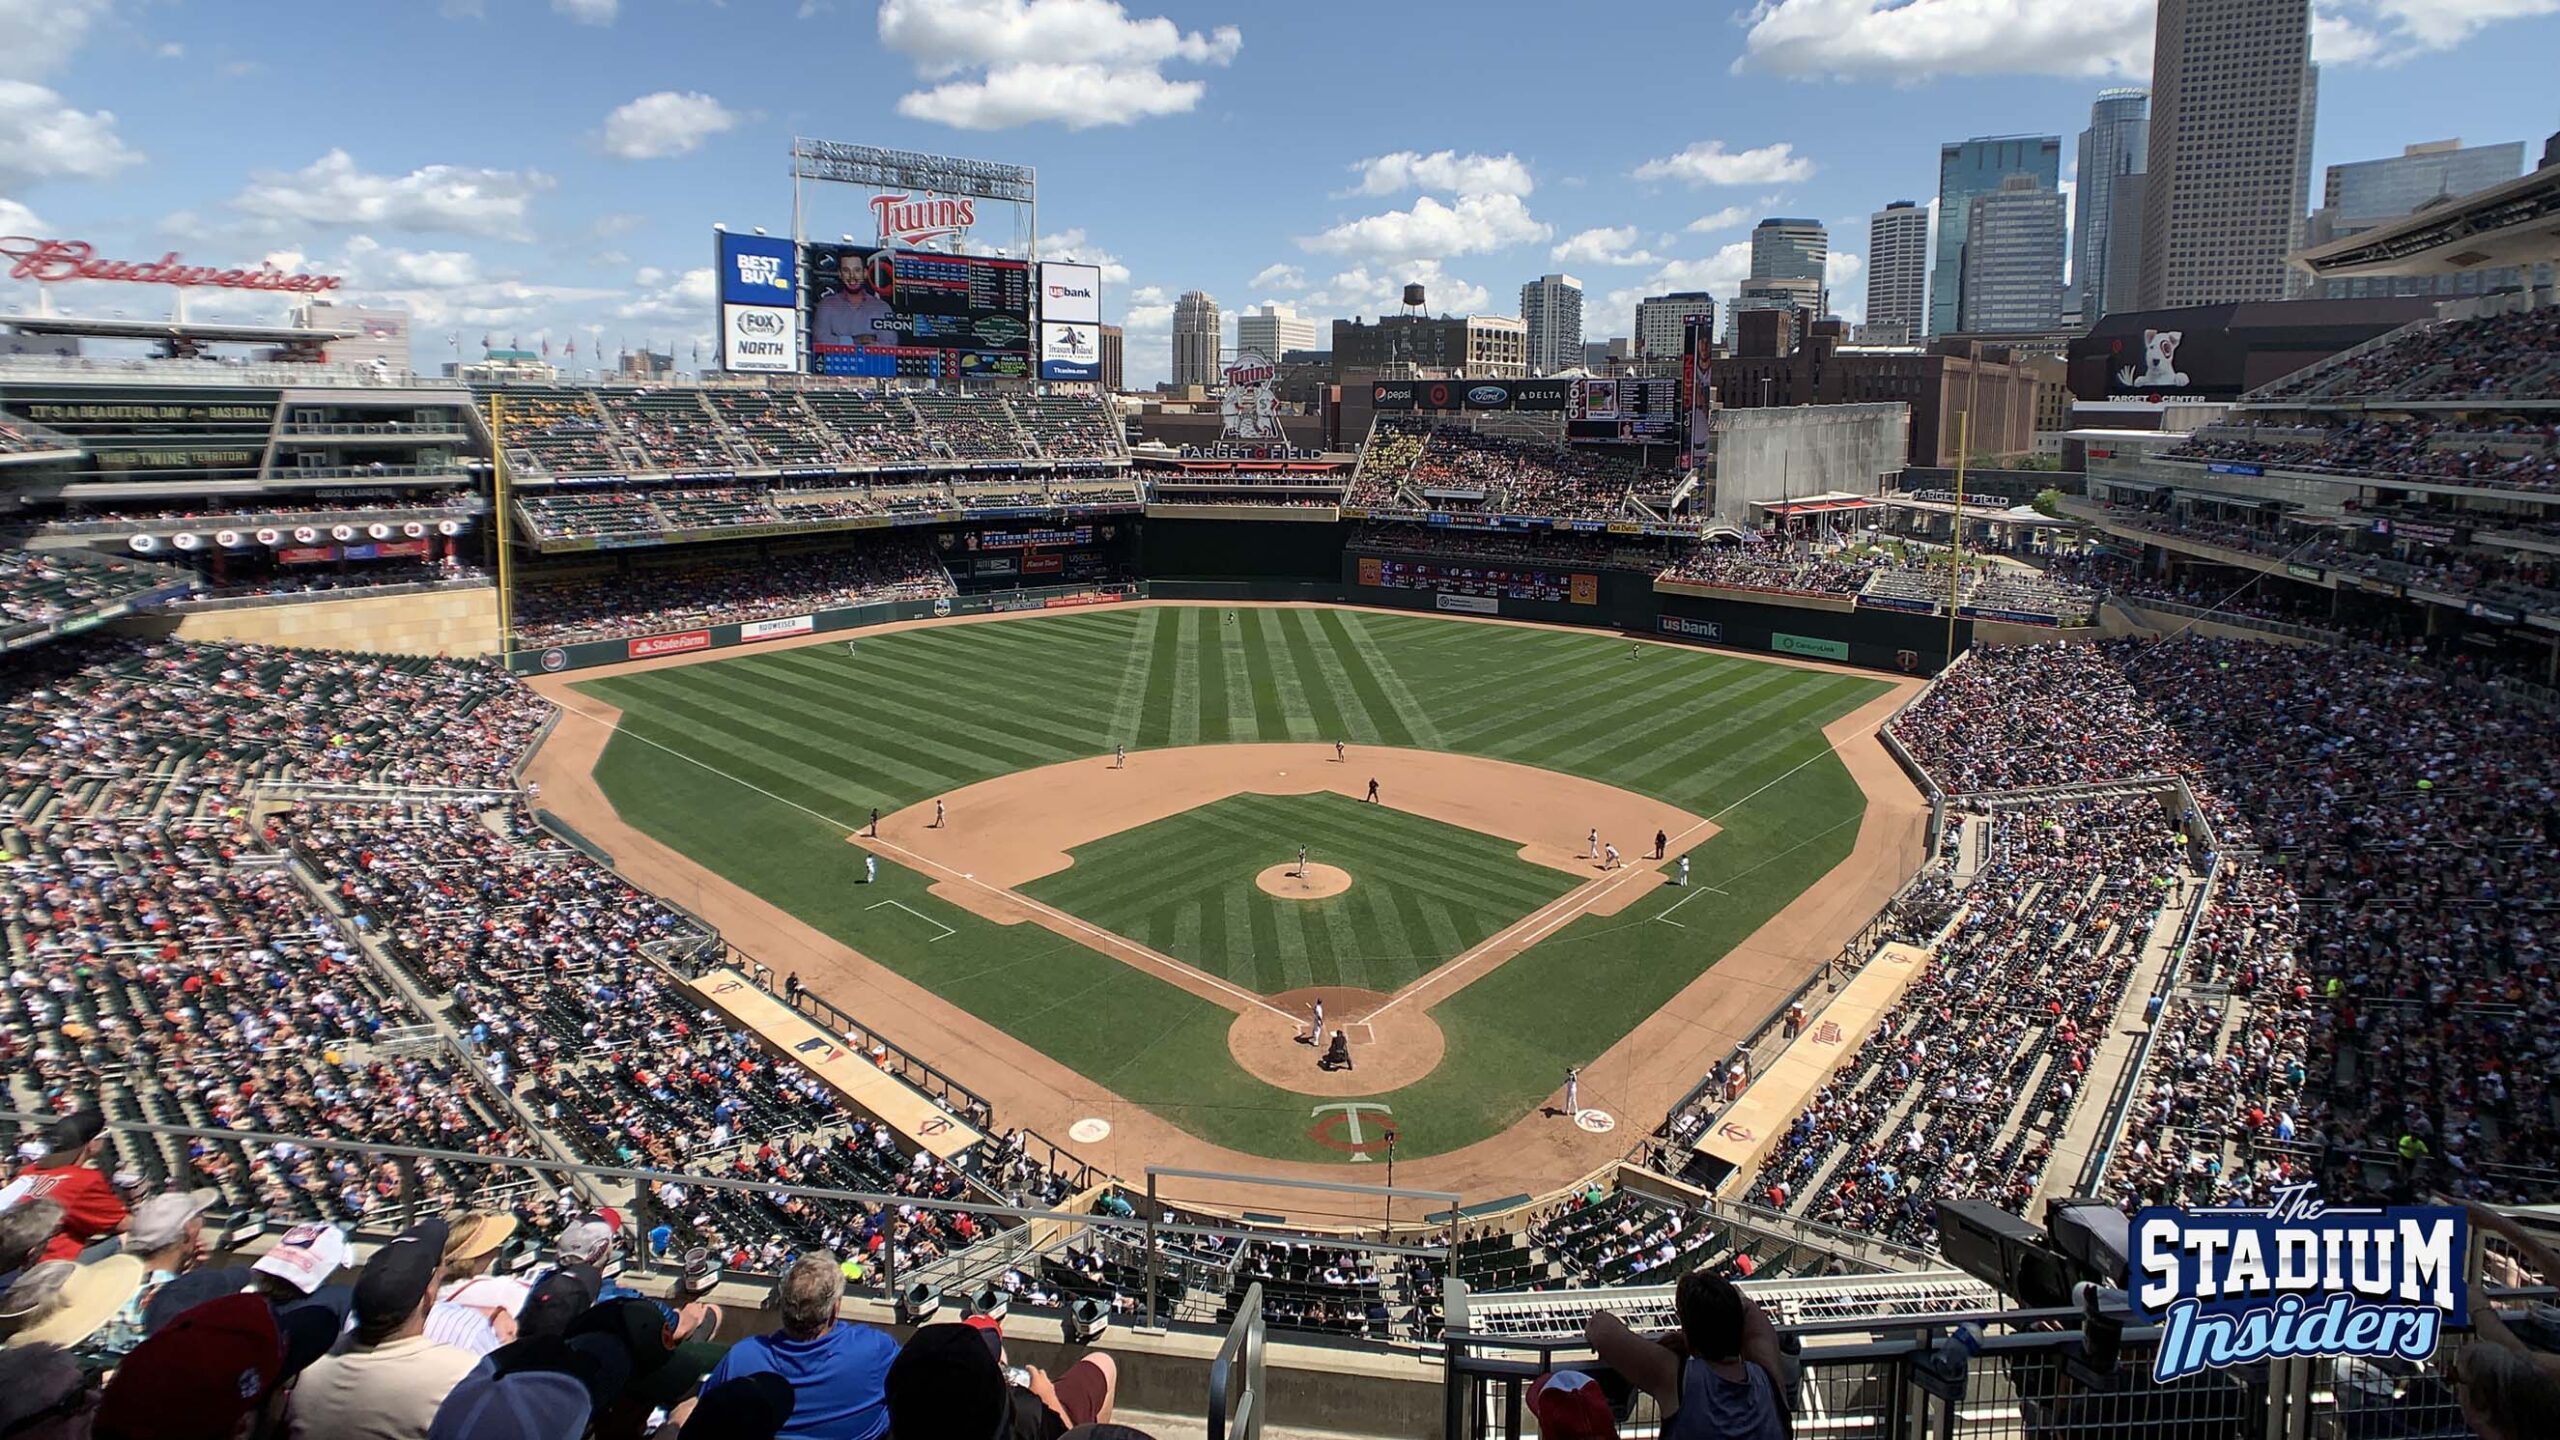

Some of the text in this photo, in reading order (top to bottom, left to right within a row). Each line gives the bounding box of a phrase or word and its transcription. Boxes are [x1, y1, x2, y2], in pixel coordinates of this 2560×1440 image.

[869, 189, 975, 239] Twins
[0, 236, 342, 292] Budweiser
[737, 254, 780, 271] BEST
[741, 269, 776, 285] BUY
[747, 314, 774, 327] FOX
[873, 320, 912, 330] CRON
[738, 341, 783, 355] NORTH
[1224, 364, 1274, 388] Twins
[1387, 391, 1411, 400] pepsi
[1475, 390, 1501, 401] Ford
[1529, 391, 1561, 399] DELTA
[1569, 379, 1580, 419] CRON
[2162, 395, 2206, 403] CENTER
[66, 406, 78, 418] A
[81, 405, 158, 418] BEAUTIFUL
[160, 405, 182, 418] DAY
[209, 408, 269, 418] BASEBALL
[139, 452, 187, 465] TWINS
[192, 452, 249, 462] TERRITORY
[1181, 447, 1323, 460] TARGET FIELD
[1972, 494, 2009, 505] FIELD
[758, 620, 796, 632] BUDWEISER
[1811, 1020, 1845, 1046] Twins
